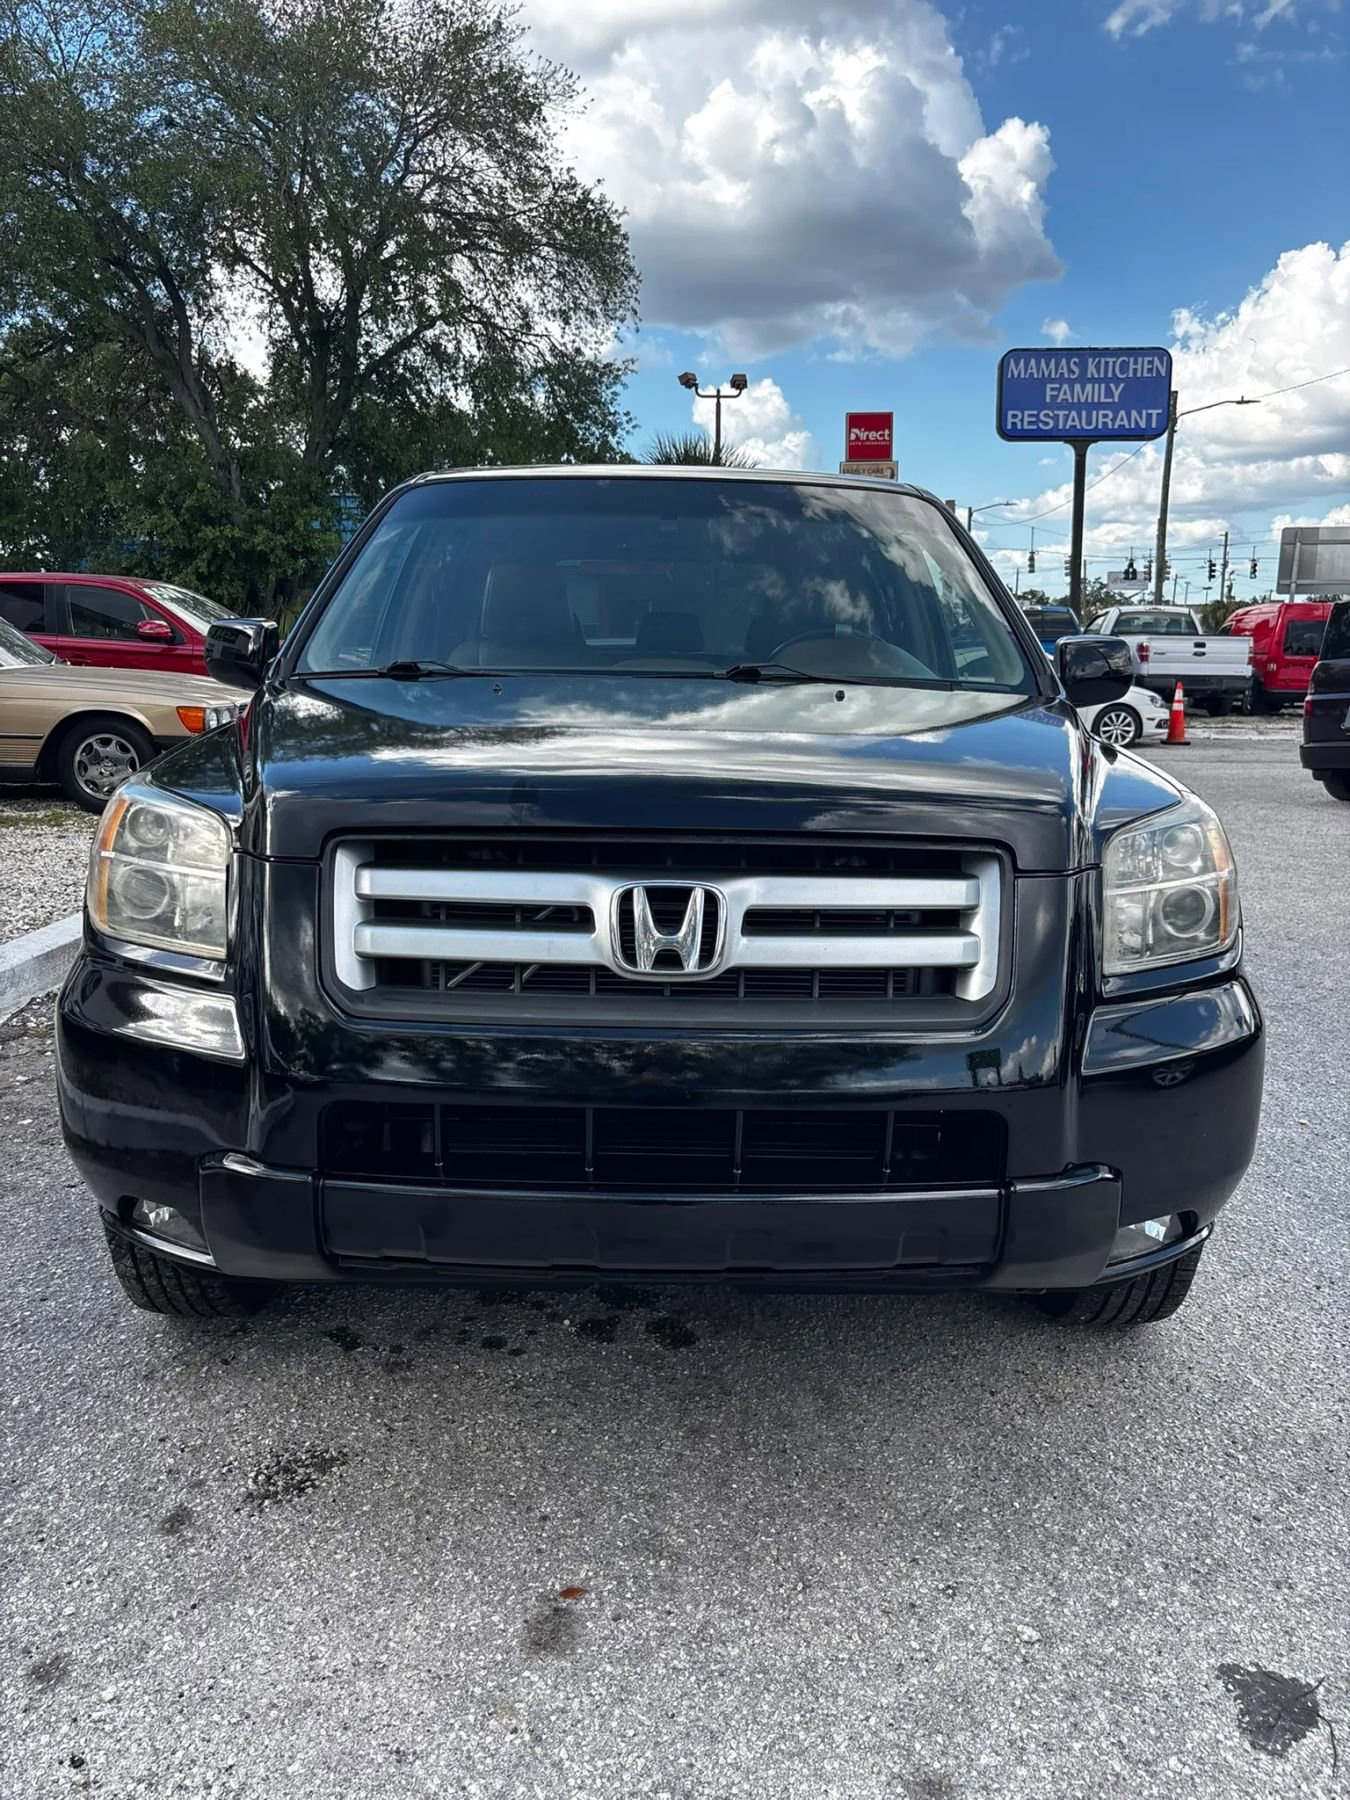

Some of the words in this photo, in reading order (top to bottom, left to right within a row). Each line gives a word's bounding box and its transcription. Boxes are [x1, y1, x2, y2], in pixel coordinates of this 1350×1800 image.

[1007, 357, 1079, 379] MAMAS
[1087, 356, 1167, 379] KITCHEN
[1045, 383, 1125, 403] FAMILY
[1006, 409, 1163, 430] RESTAURANT
[850, 428, 890, 441] Direct
